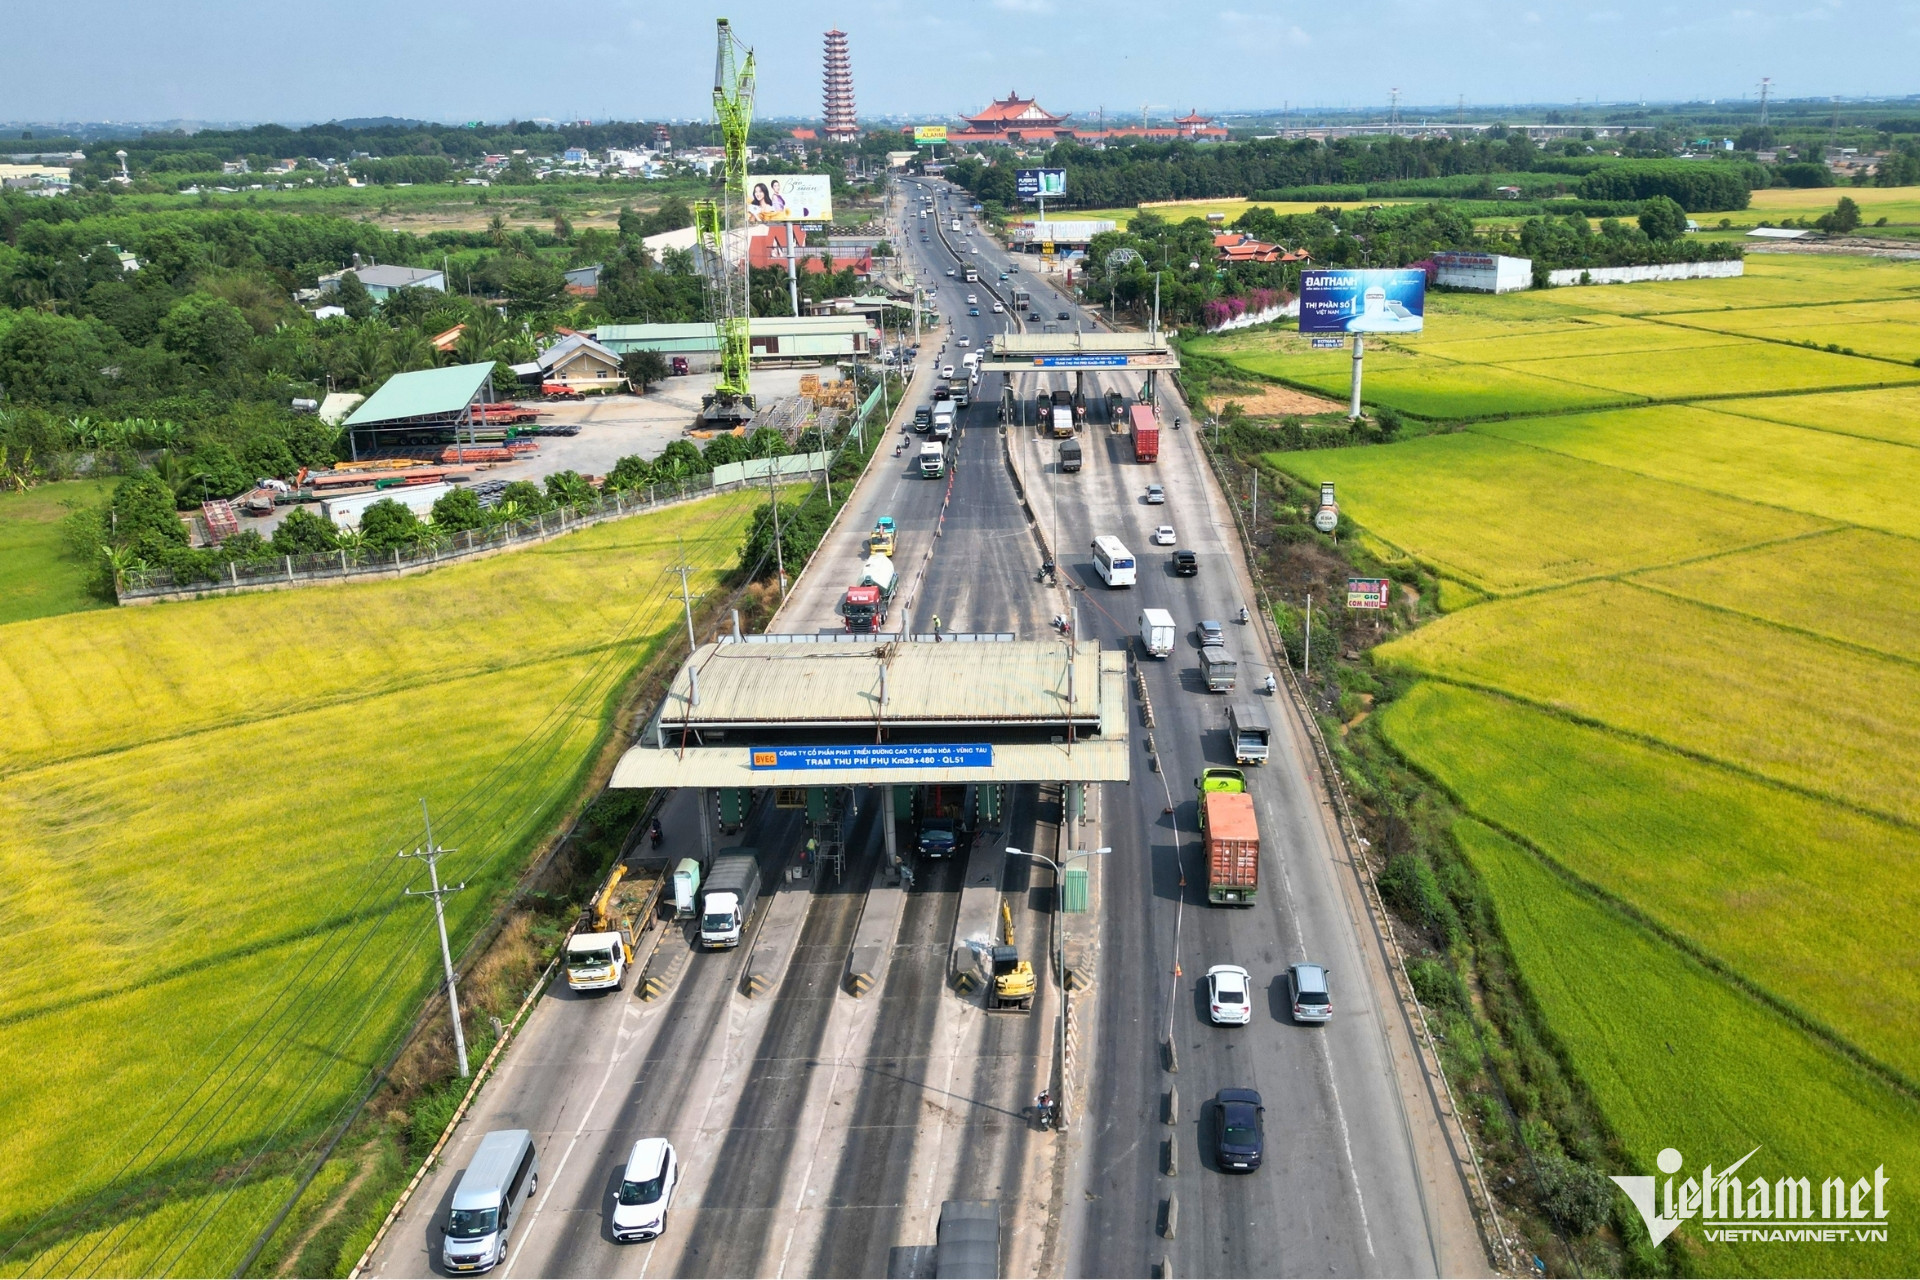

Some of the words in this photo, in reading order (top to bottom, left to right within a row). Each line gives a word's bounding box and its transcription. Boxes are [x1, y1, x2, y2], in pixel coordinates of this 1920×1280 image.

[778, 749, 797, 757] CÔNG
[755, 755, 775, 763] BVEC
[853, 756, 869, 765] PHÍ
[870, 757, 889, 766] PHỤ
[891, 756, 935, 765] Km28+480
[942, 756, 964, 764] QL51
